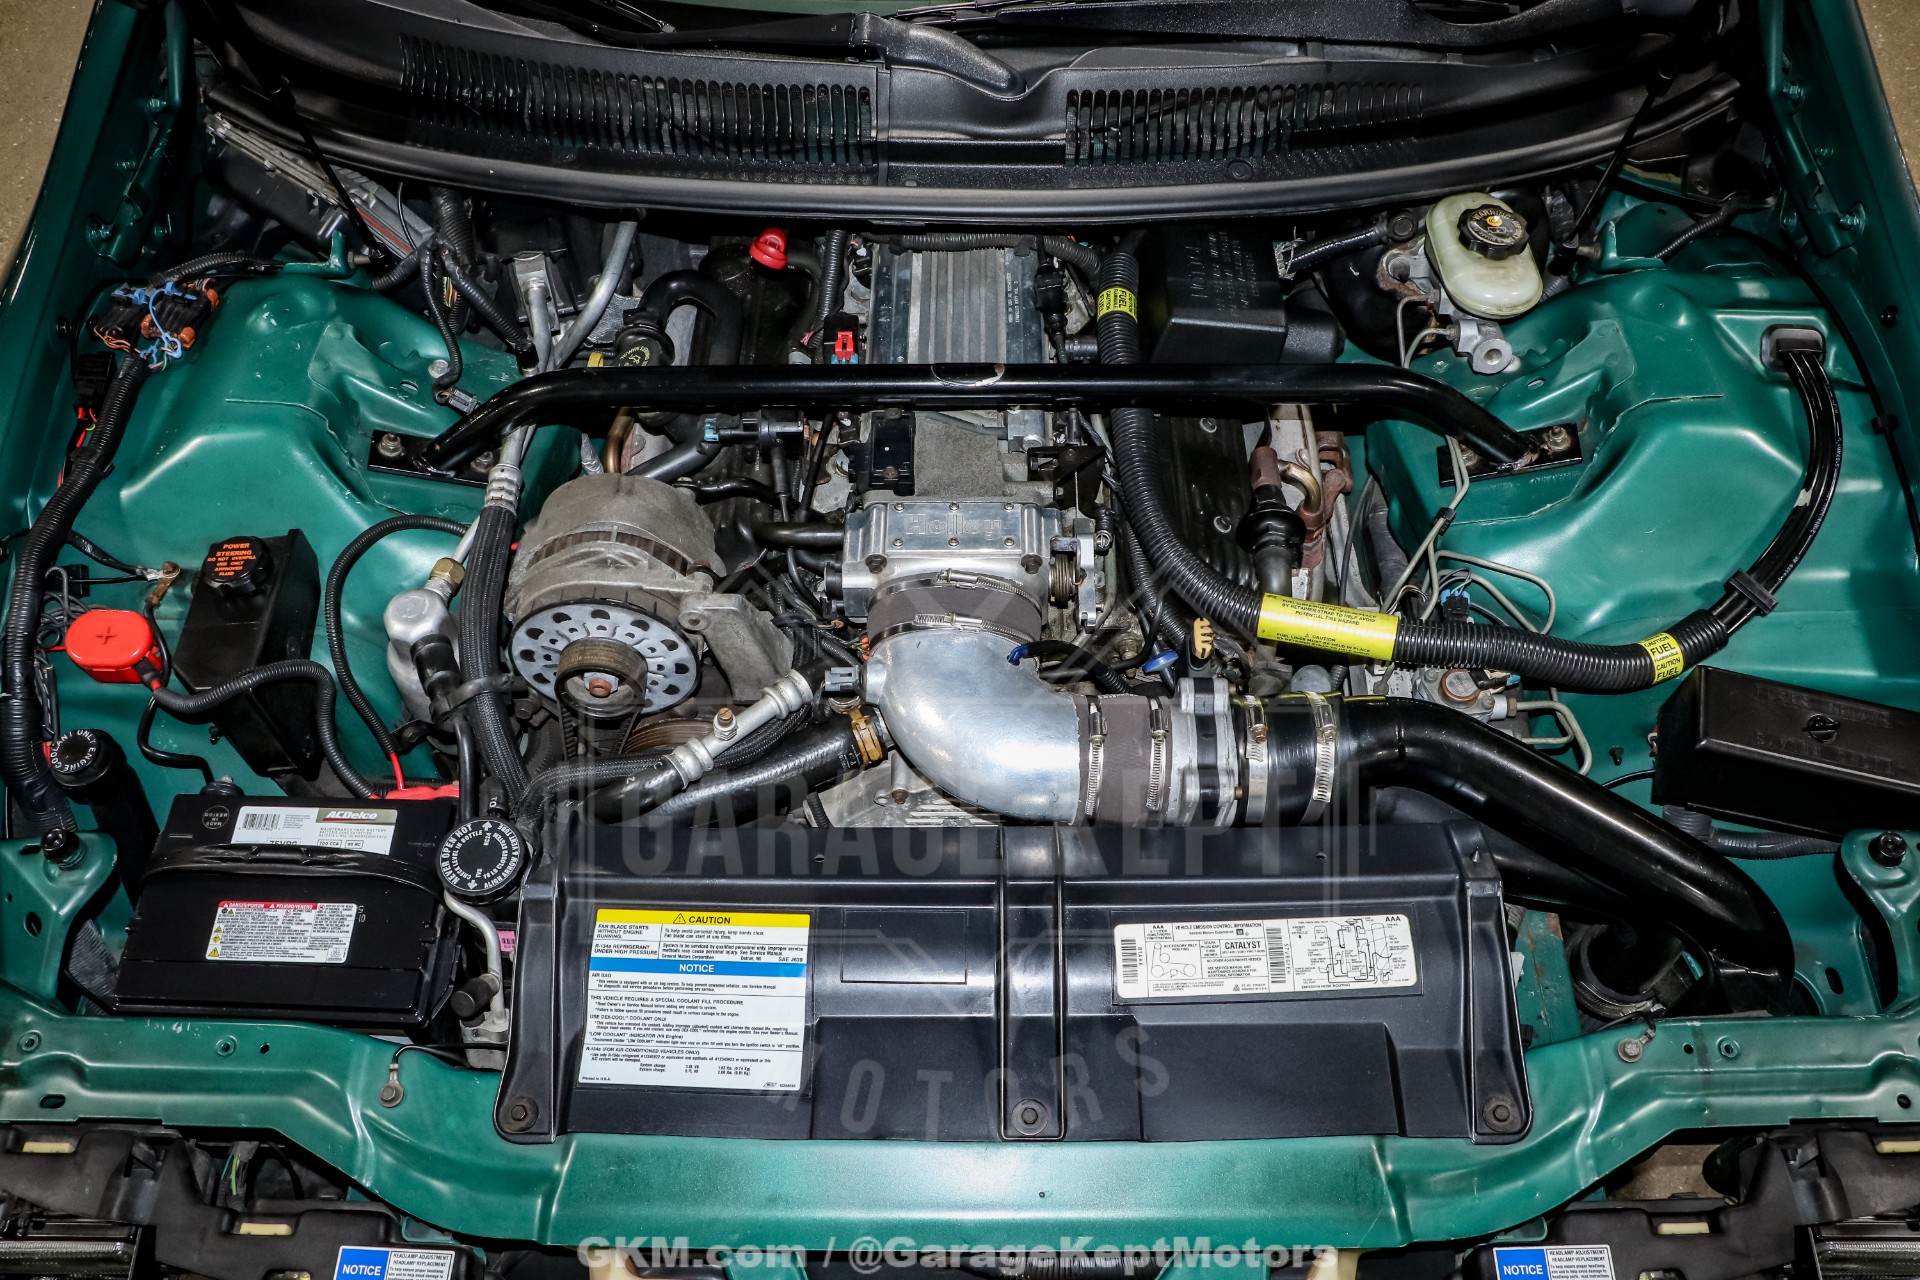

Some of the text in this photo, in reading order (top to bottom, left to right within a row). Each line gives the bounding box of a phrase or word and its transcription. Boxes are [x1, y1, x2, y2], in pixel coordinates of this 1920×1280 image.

[1472, 209, 1510, 220] WARNING
[905, 514, 1001, 540] Holley
[1290, 604, 1316, 612] RETAINER
[1295, 610, 1324, 620] POTENTIAL
[1644, 636, 1669, 647] CAUTION
[1650, 642, 1676, 656] FUEL
[1656, 657, 1680, 670] CAUTION
[1657, 667, 1679, 680] FUEL
[50, 730, 97, 771] ENGINE COOLANT ONLY
[326, 811, 378, 819] ACDelco
[461, 830, 482, 843] BOTTLE
[497, 824, 514, 837] TUBE
[492, 832, 508, 849] SYSTEM
[508, 834, 518, 850] VENT
[442, 824, 473, 885] NEVER OPEN HOT
[497, 850, 508, 869] CLOSED
[502, 857, 518, 878] ARROW
[456, 869, 472, 880] CHECK
[484, 876, 502, 889] ALIGN
[689, 916, 730, 924] CAUTION
[1225, 941, 1260, 949] CATALYST
[680, 964, 714, 972] NOTICE
[342, 1264, 382, 1276] NOTICE
[1504, 1264, 1543, 1275] NOTICE
